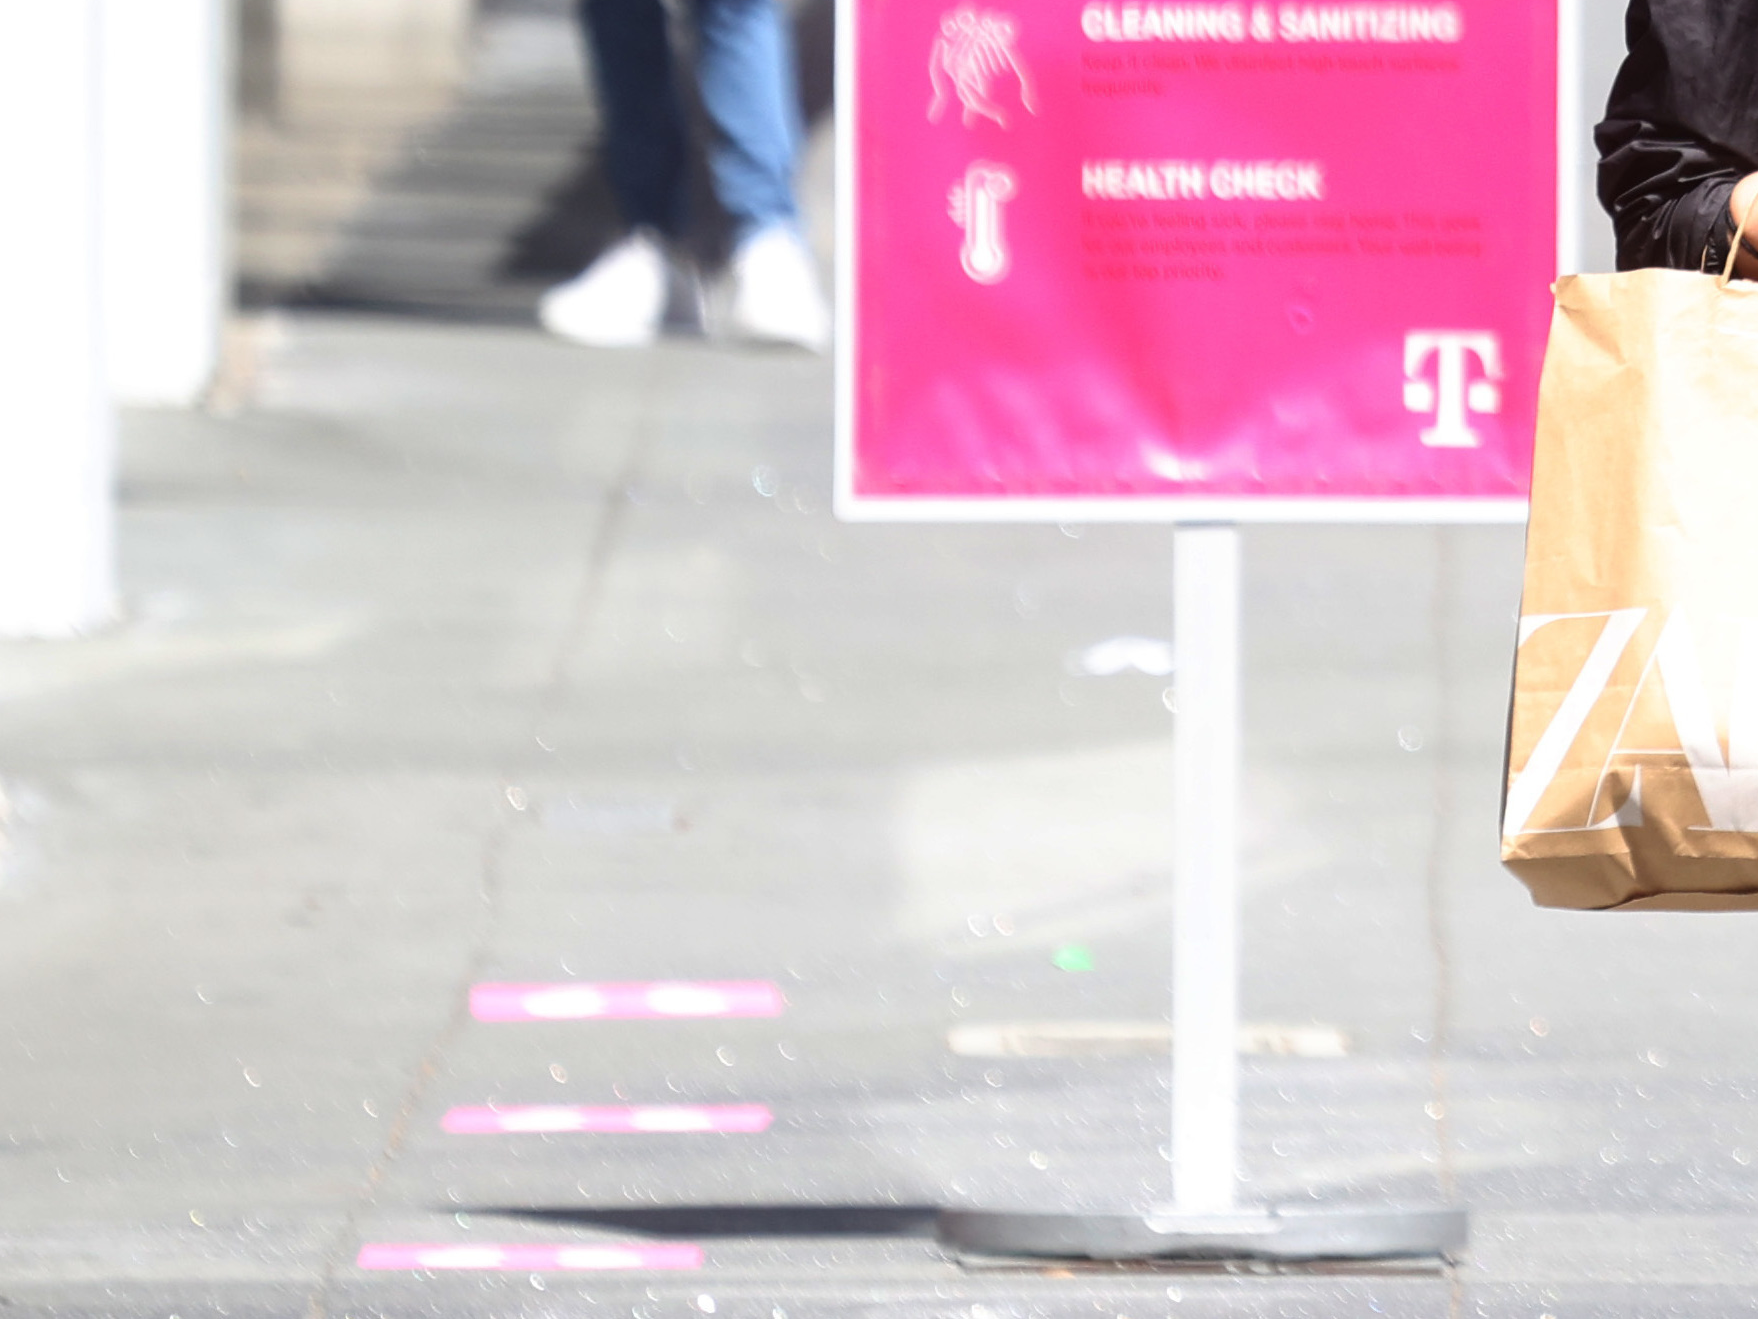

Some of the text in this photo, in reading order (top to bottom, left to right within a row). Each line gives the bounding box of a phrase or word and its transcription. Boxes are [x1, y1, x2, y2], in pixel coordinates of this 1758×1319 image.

[1081, 1, 1463, 42] CLEANING & SANITIZING
[1081, 158, 1325, 200] HEALTH CHECK
[1403, 329, 1502, 448] T
